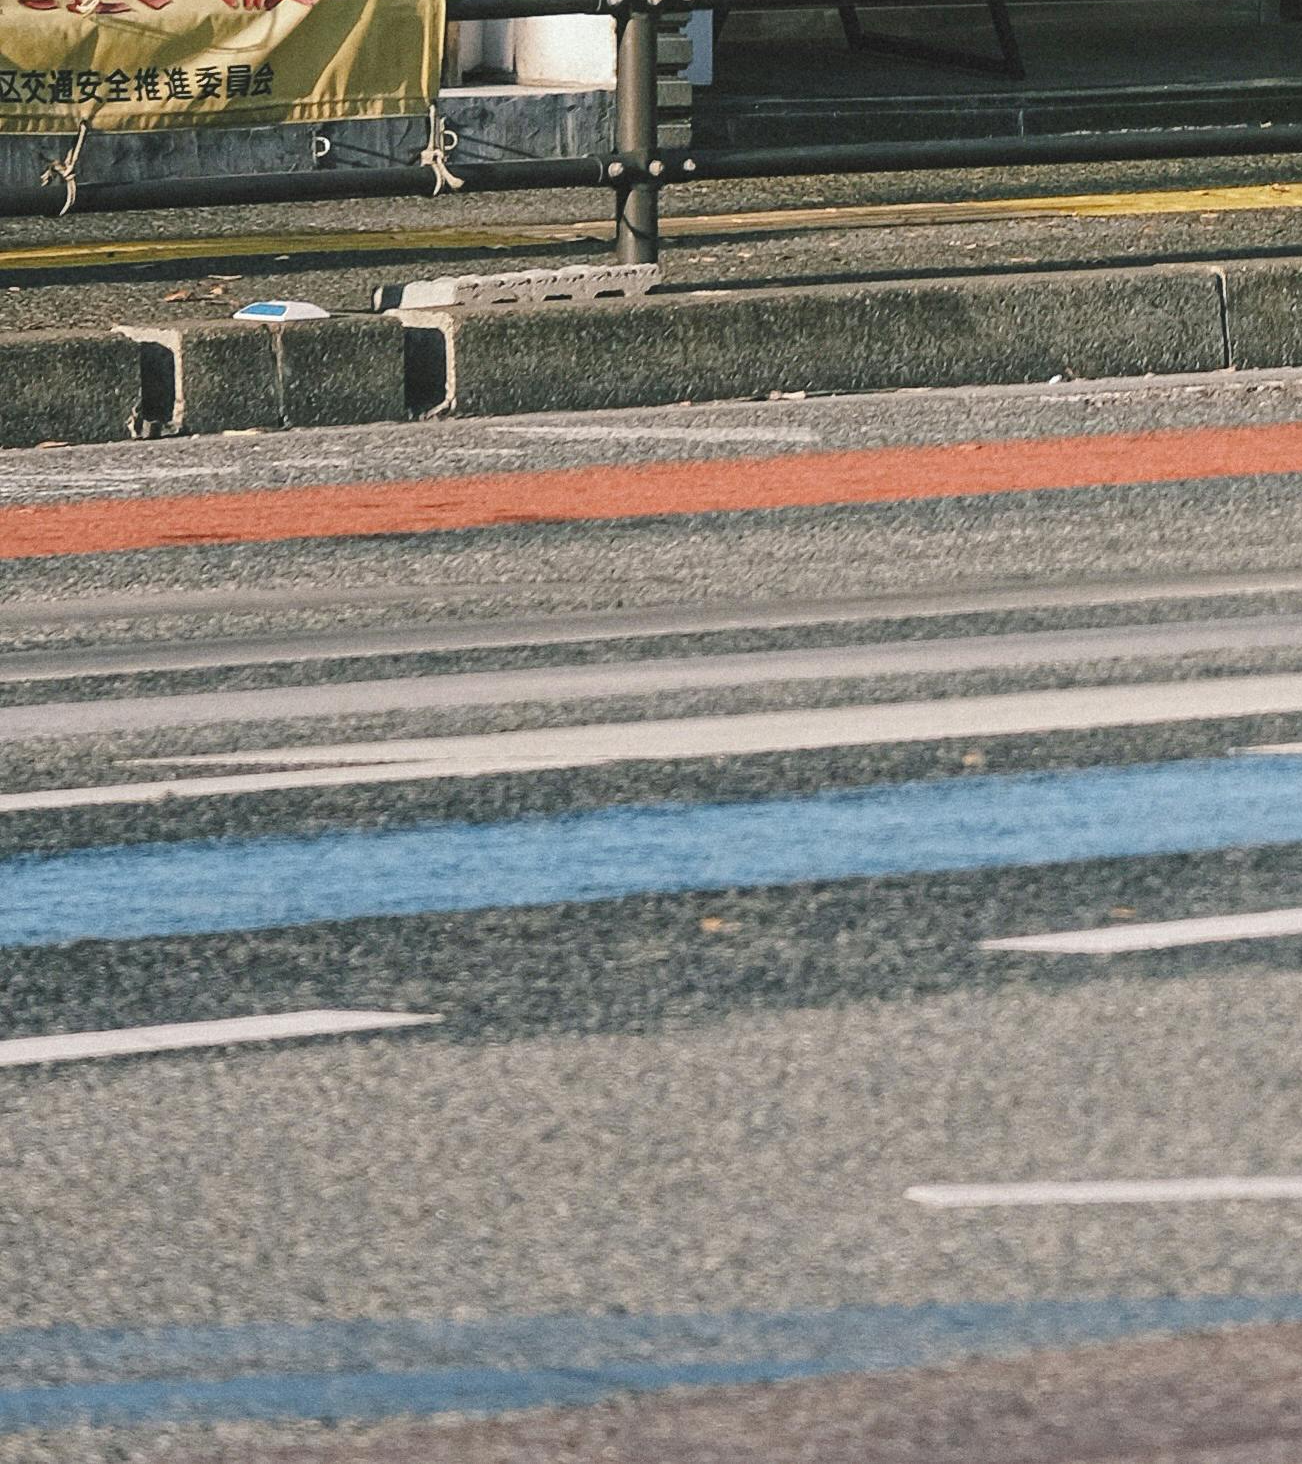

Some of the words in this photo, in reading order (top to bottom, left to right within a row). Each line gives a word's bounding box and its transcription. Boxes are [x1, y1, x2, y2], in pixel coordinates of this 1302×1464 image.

[0, 61, 275, 104] 区交通安全推進委員会
